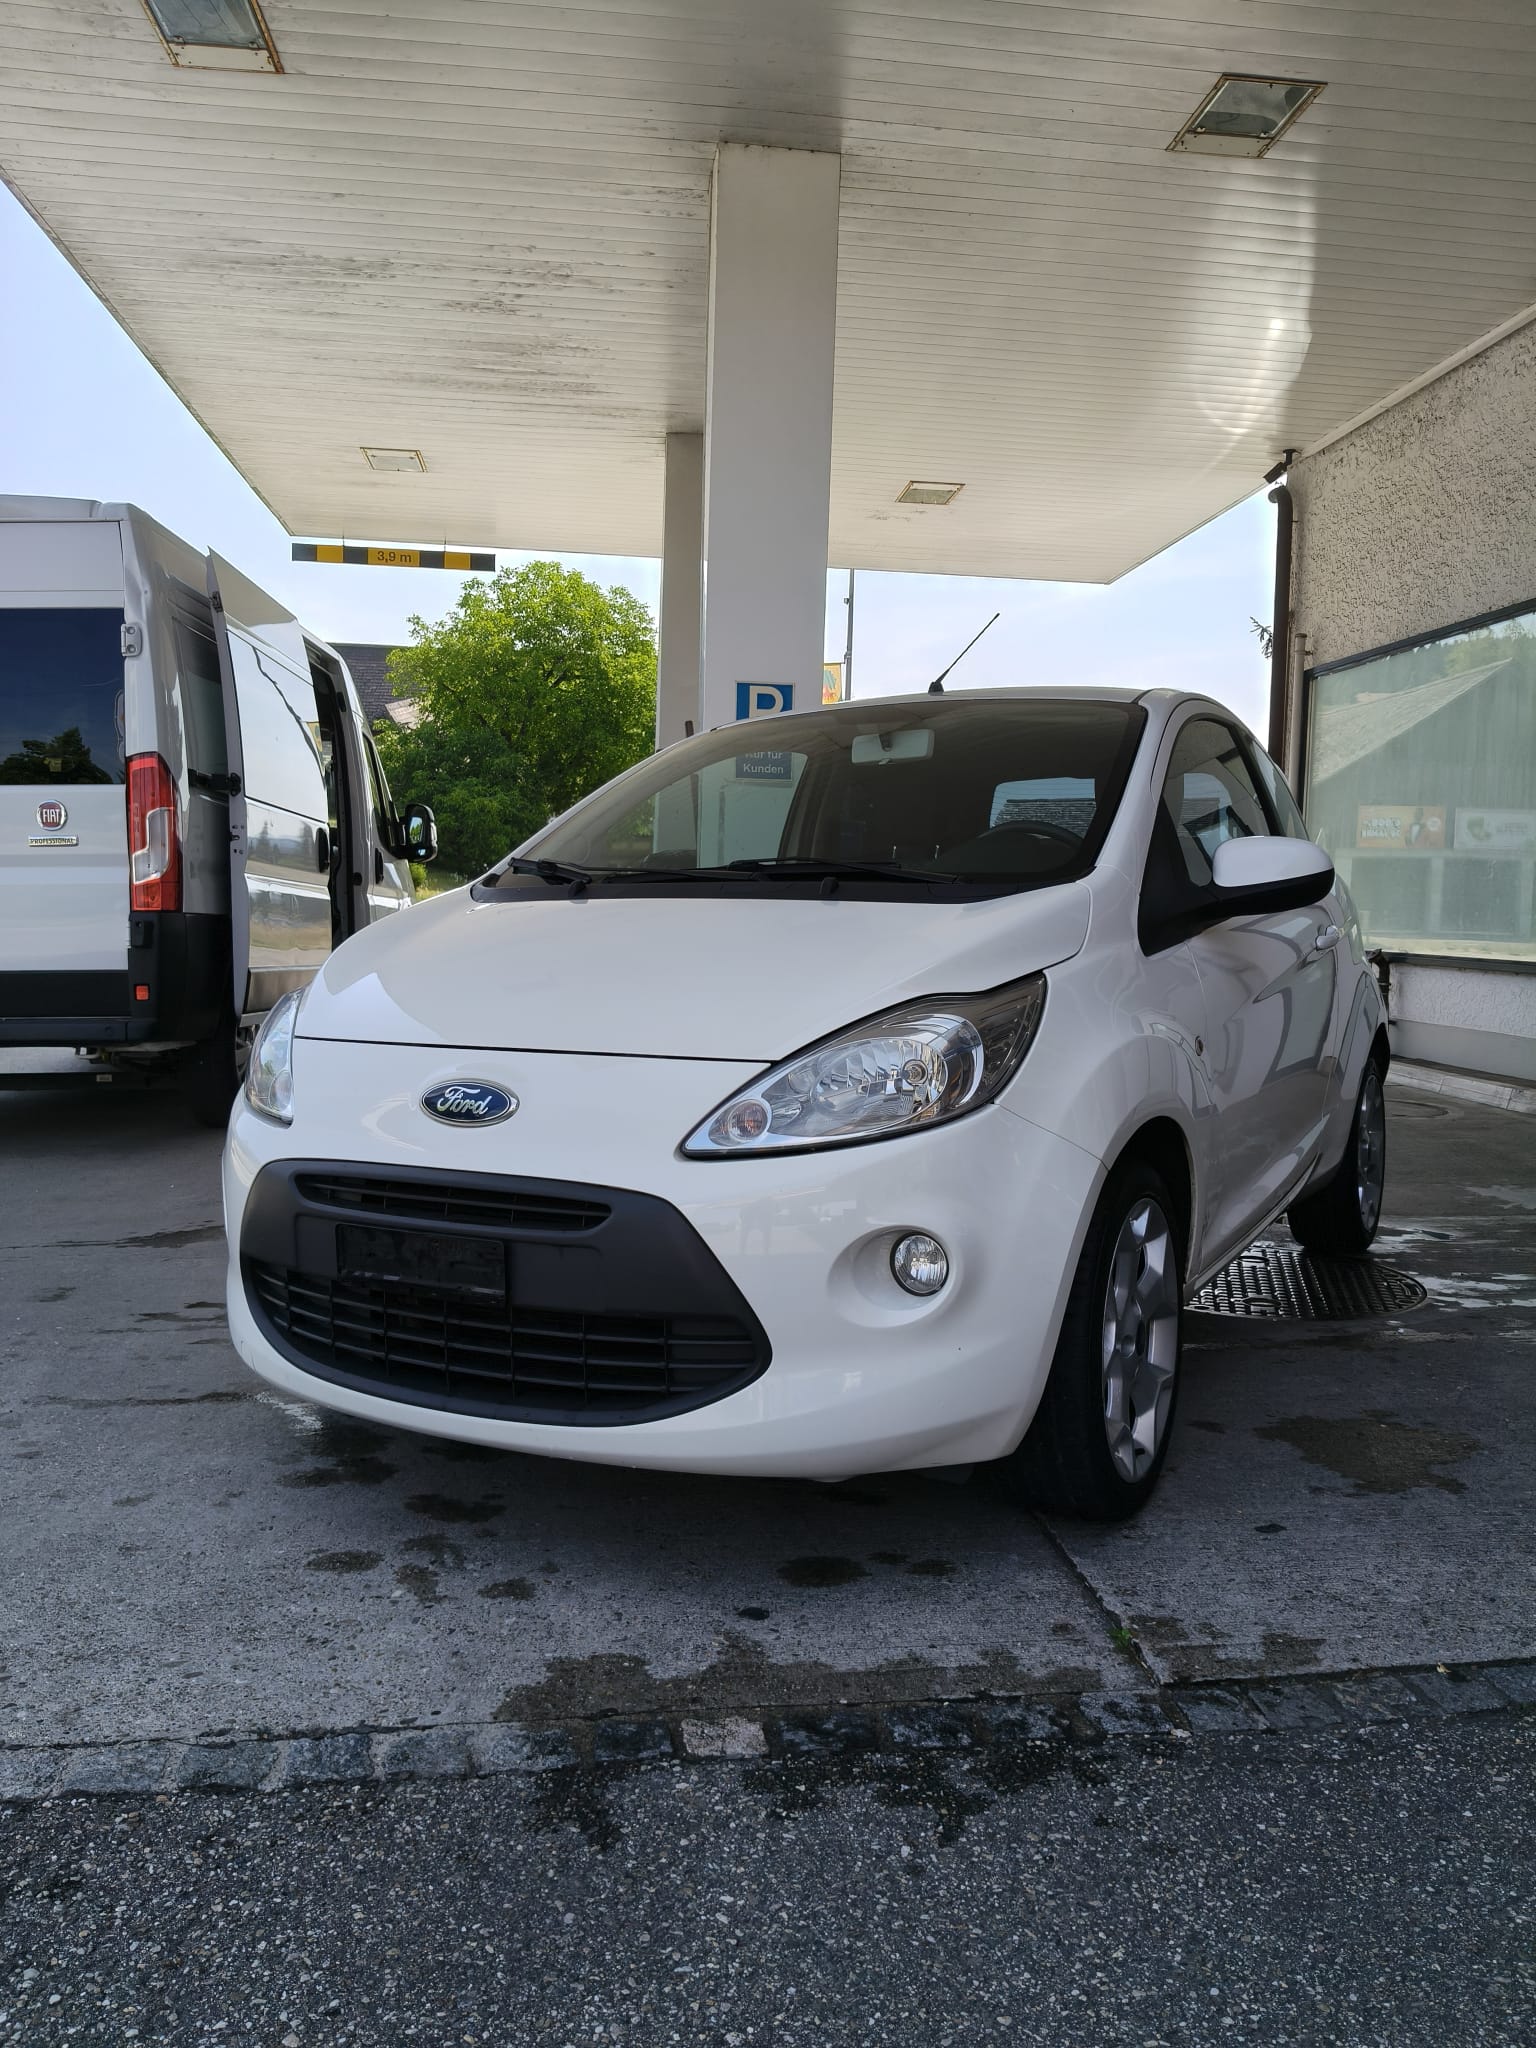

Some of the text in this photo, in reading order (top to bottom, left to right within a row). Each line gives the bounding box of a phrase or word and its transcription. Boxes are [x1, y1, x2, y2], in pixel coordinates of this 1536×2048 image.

[377, 551, 412, 563] 3,9 m
[748, 685, 784, 720] P
[743, 763, 784, 774] Kunden
[42, 808, 61, 823] FIAT
[30, 837, 74, 845] PROFESSIONAL
[437, 1086, 493, 1115] Ford
